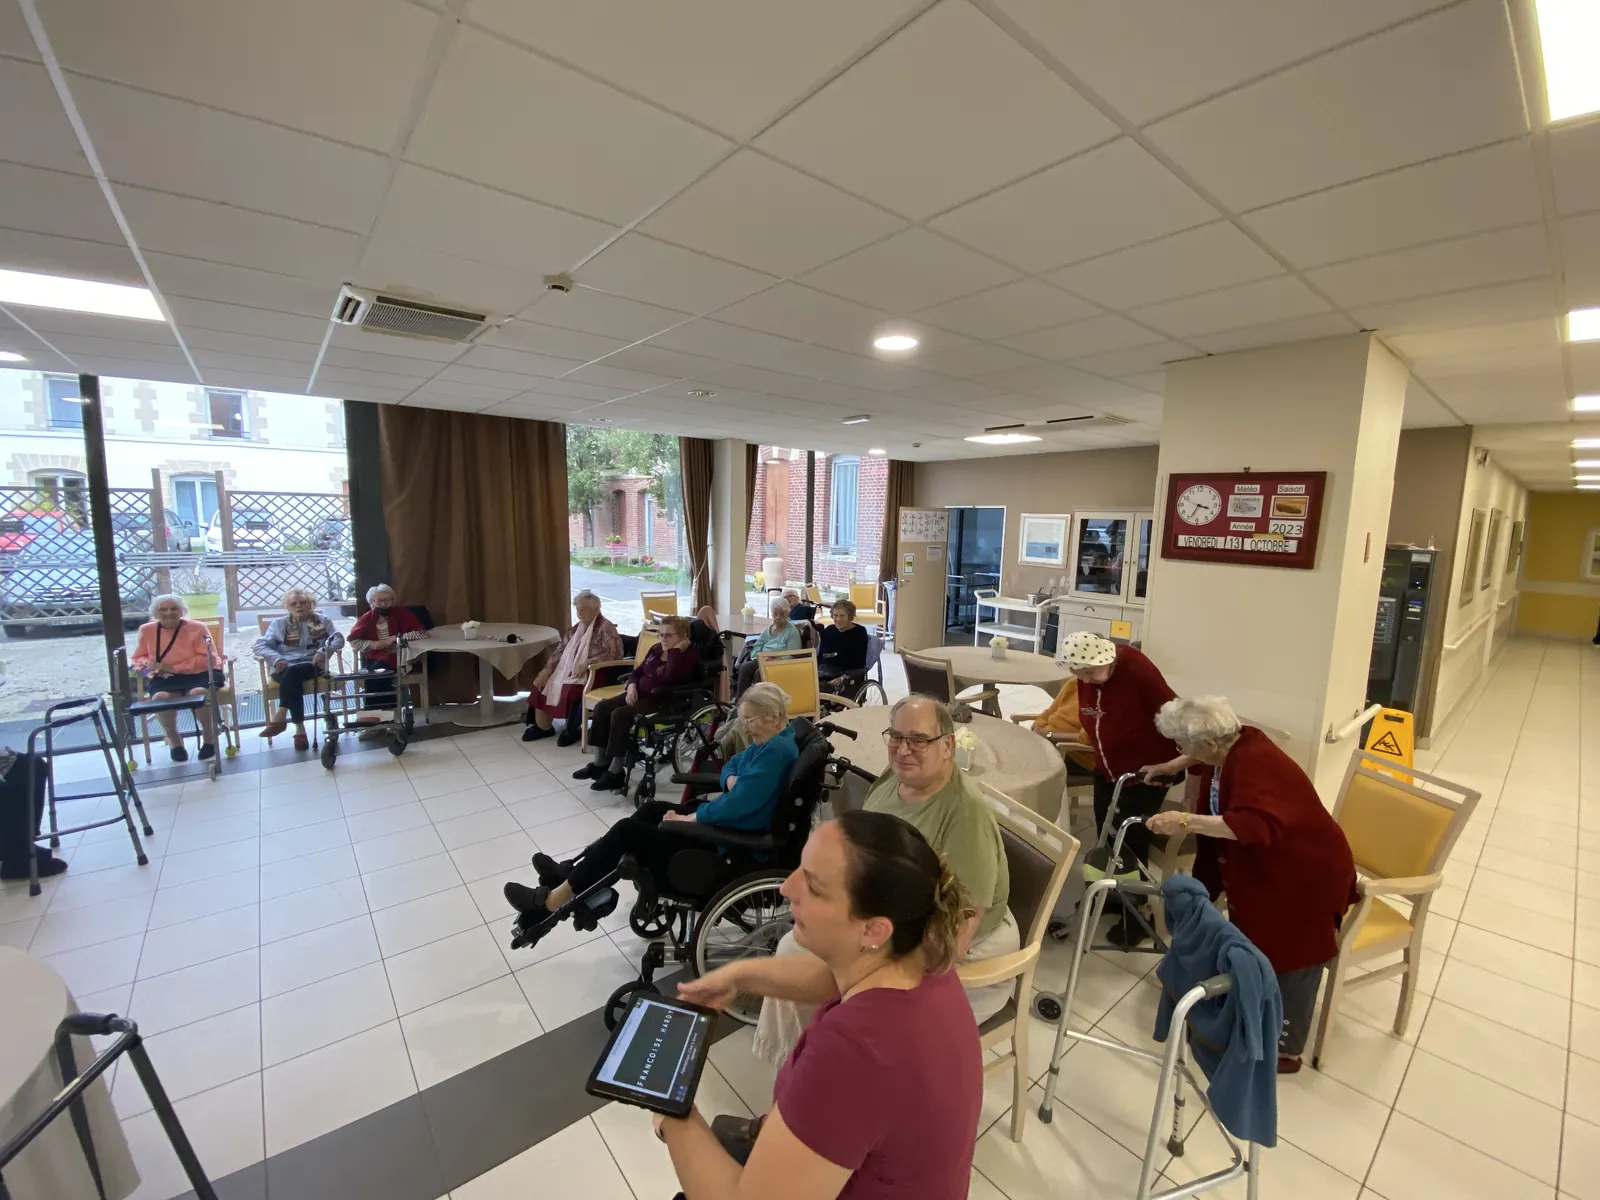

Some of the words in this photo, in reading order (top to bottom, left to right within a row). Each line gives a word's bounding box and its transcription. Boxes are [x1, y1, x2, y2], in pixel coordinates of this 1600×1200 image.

[1272, 523, 1303, 535] 2023
[1184, 536, 1218, 548] VENDREDI
[1229, 537, 1240, 549] 13
[1250, 539, 1290, 552] OCTOBRE
[636, 1037, 663, 1087] FRANCOISE
[660, 1010, 674, 1033] HARDY
